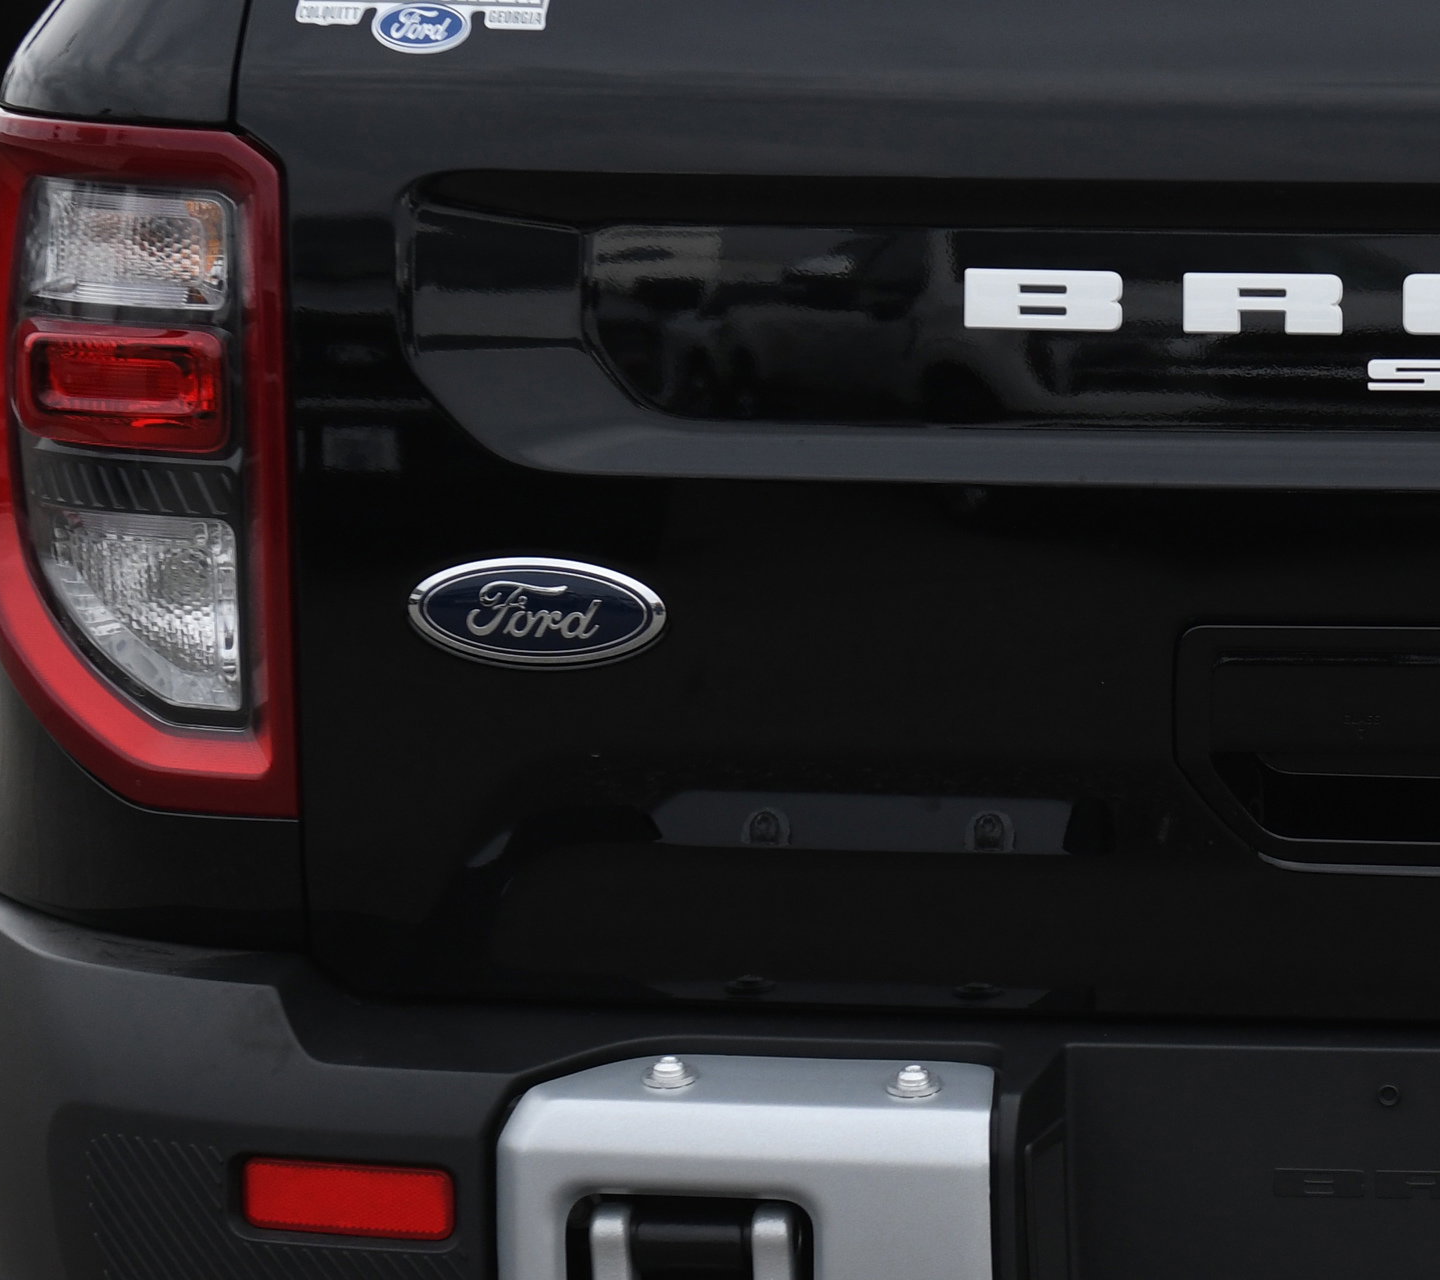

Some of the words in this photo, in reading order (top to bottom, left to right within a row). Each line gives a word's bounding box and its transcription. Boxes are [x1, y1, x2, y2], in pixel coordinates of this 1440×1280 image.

[389, 7, 452, 41] Ford
[488, 10, 542, 25] GEORGIA
[465, 580, 603, 639] Ford
